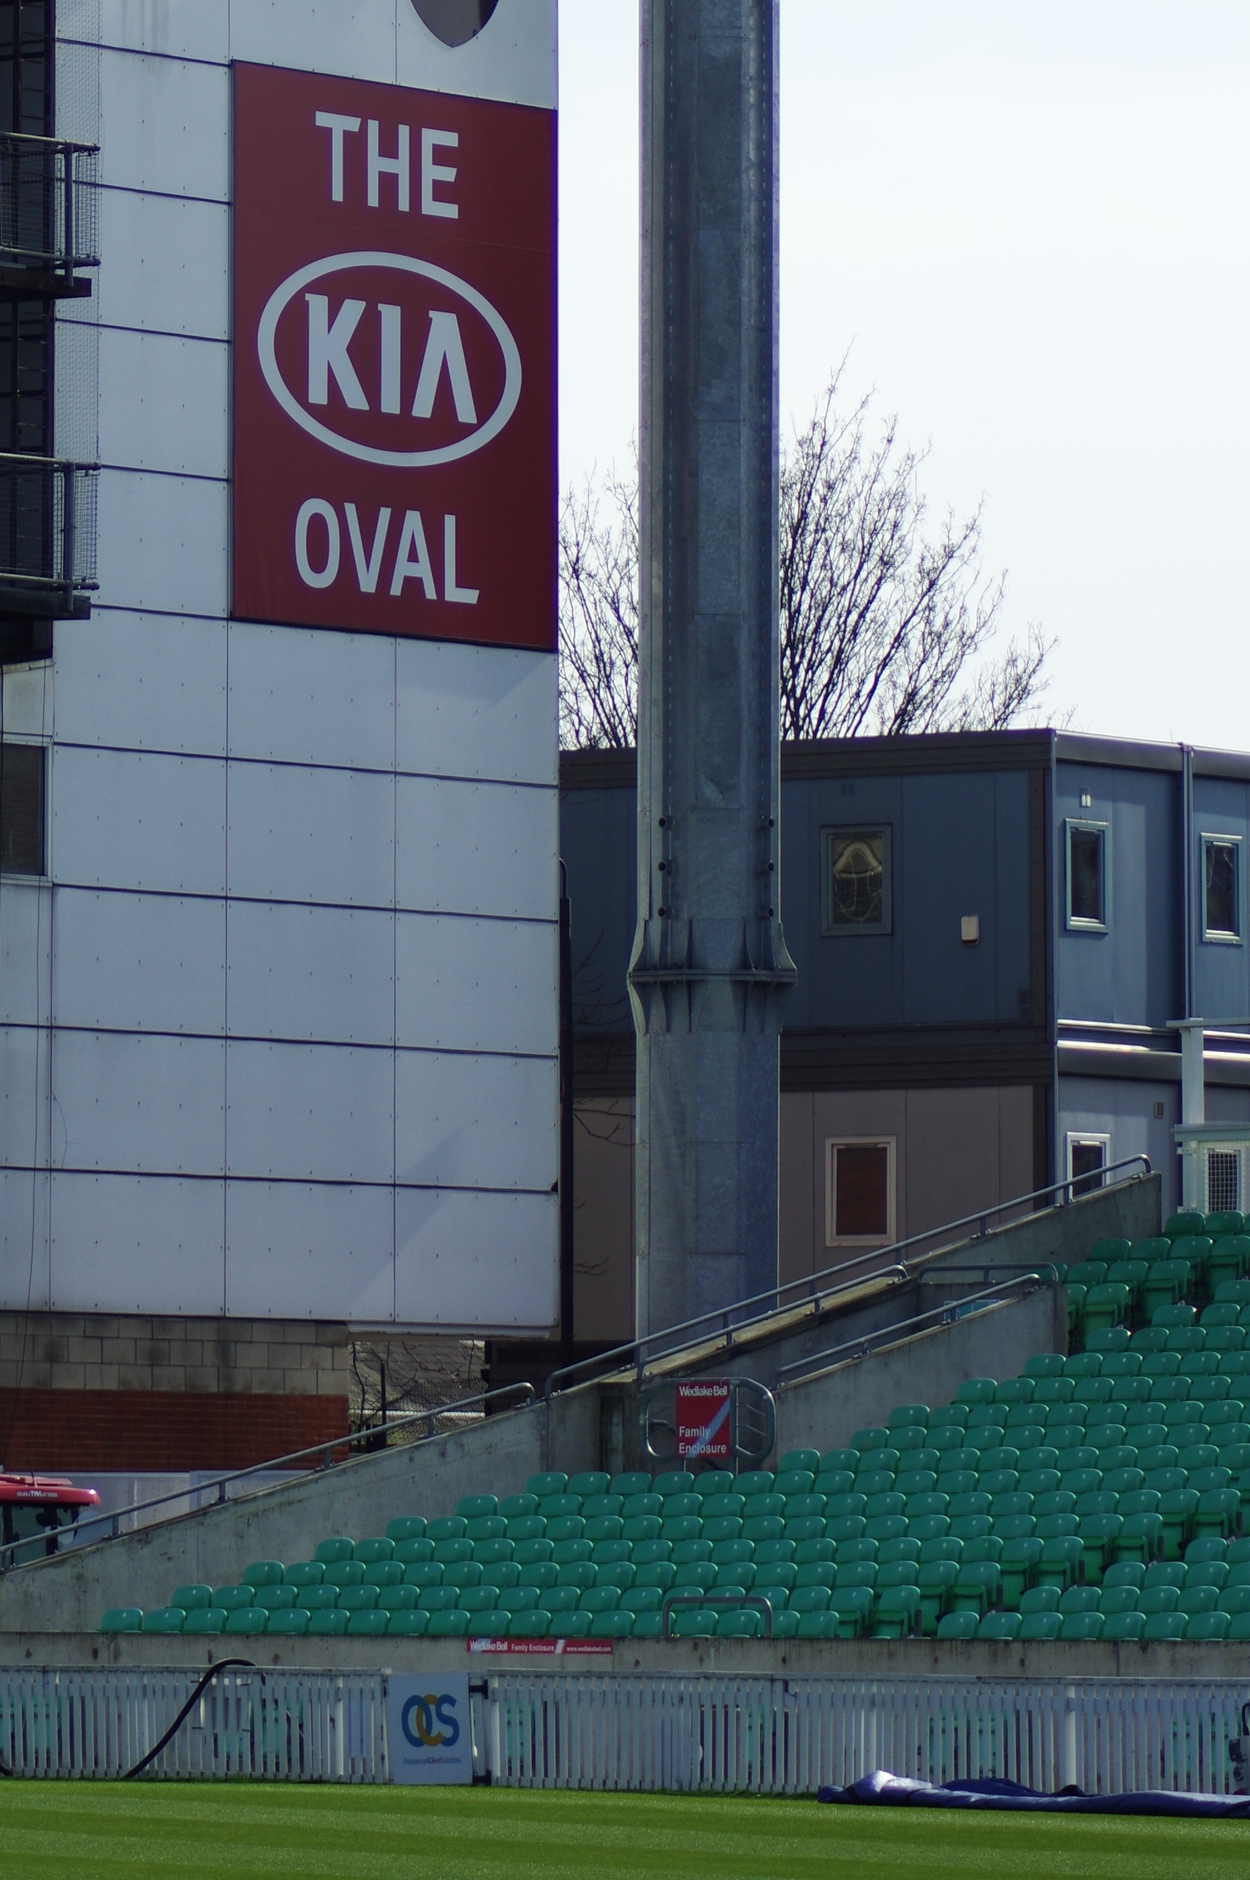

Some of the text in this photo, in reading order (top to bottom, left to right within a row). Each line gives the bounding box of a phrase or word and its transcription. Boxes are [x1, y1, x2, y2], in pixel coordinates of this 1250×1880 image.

[315, 111, 459, 219] THE
[304, 292, 479, 425] KIA
[294, 497, 480, 604] OVAL
[679, 1386, 727, 1396] Wedlake Bell
[679, 1426, 710, 1439] Family
[679, 1443, 726, 1454] Enclosure
[469, 1641, 496, 1651] Wedlake
[497, 1641, 508, 1650] Bell
[512, 1644, 528, 1652] Family
[401, 1694, 459, 1747] OCS
